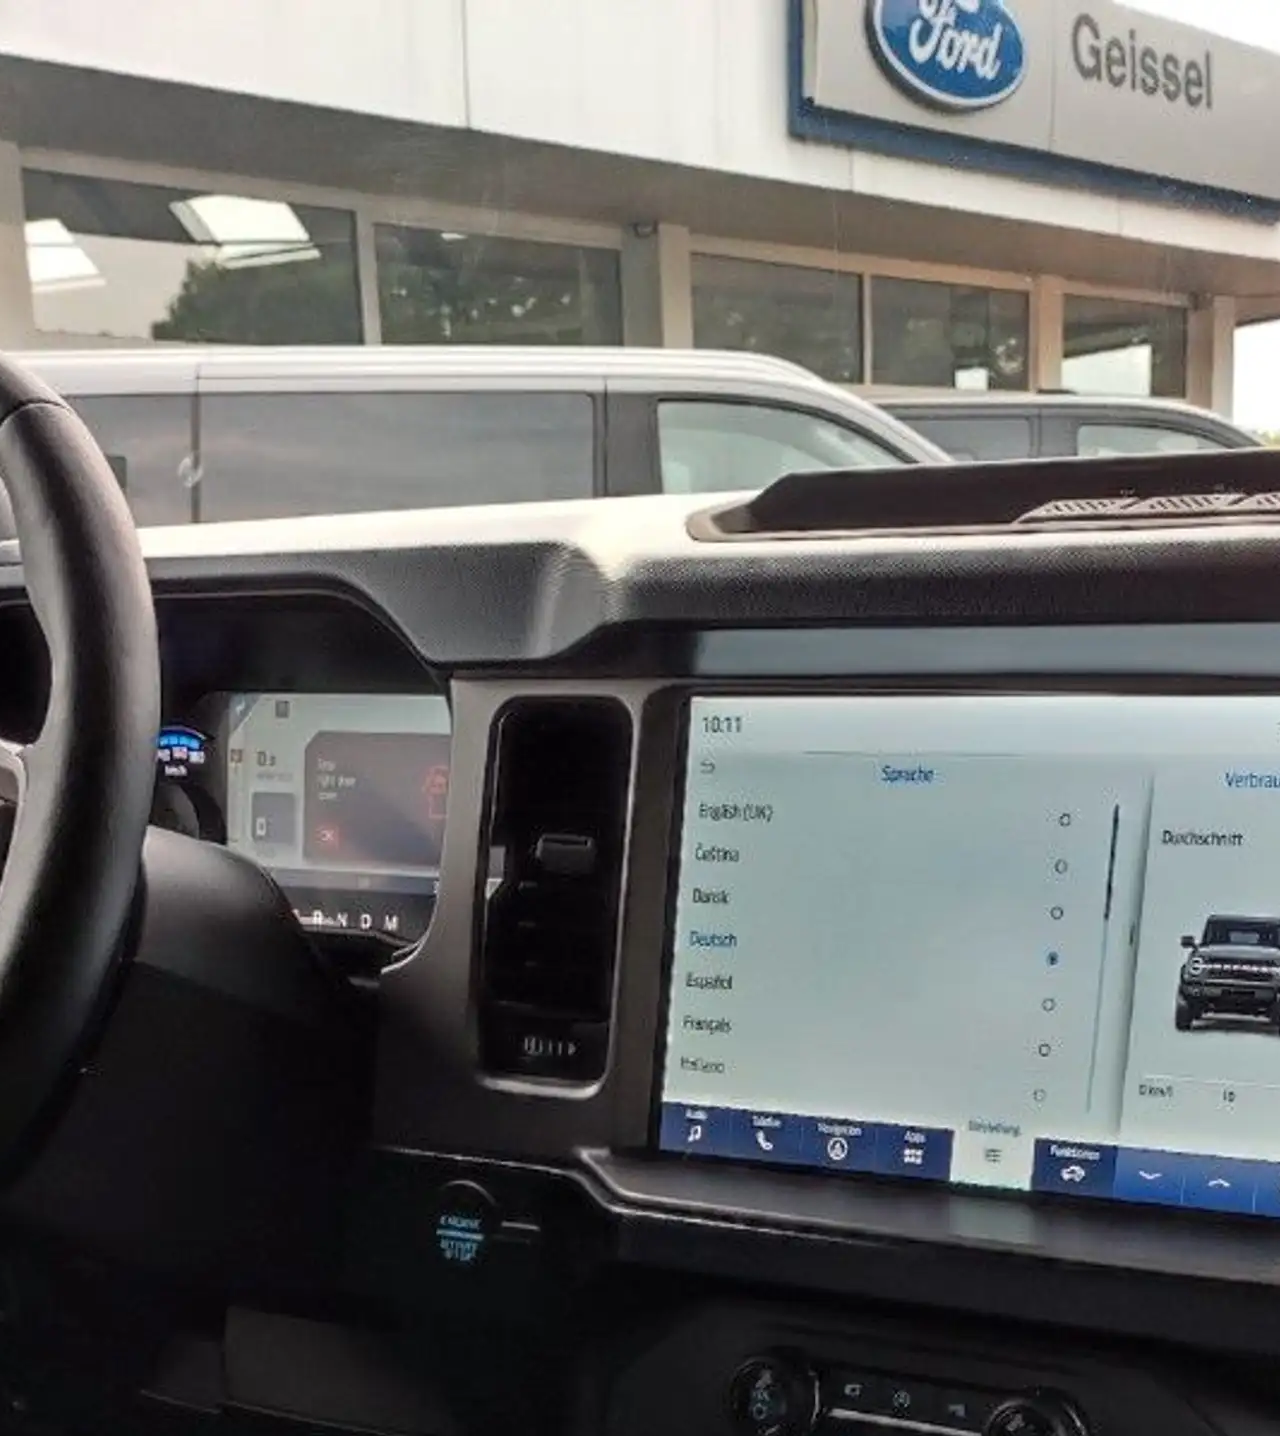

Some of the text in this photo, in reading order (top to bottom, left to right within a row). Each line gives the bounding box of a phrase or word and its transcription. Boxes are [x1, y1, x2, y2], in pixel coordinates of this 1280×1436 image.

[908, 0, 1001, 81] Ford
[1072, 13, 1213, 110] Geissel
[701, 716, 742, 733] 10:11
[881, 765, 934, 784] Sprache
[1161, 829, 1243, 847] Durchschnitt
[692, 888, 729, 904] Dansk
[689, 930, 738, 947] Deutsch
